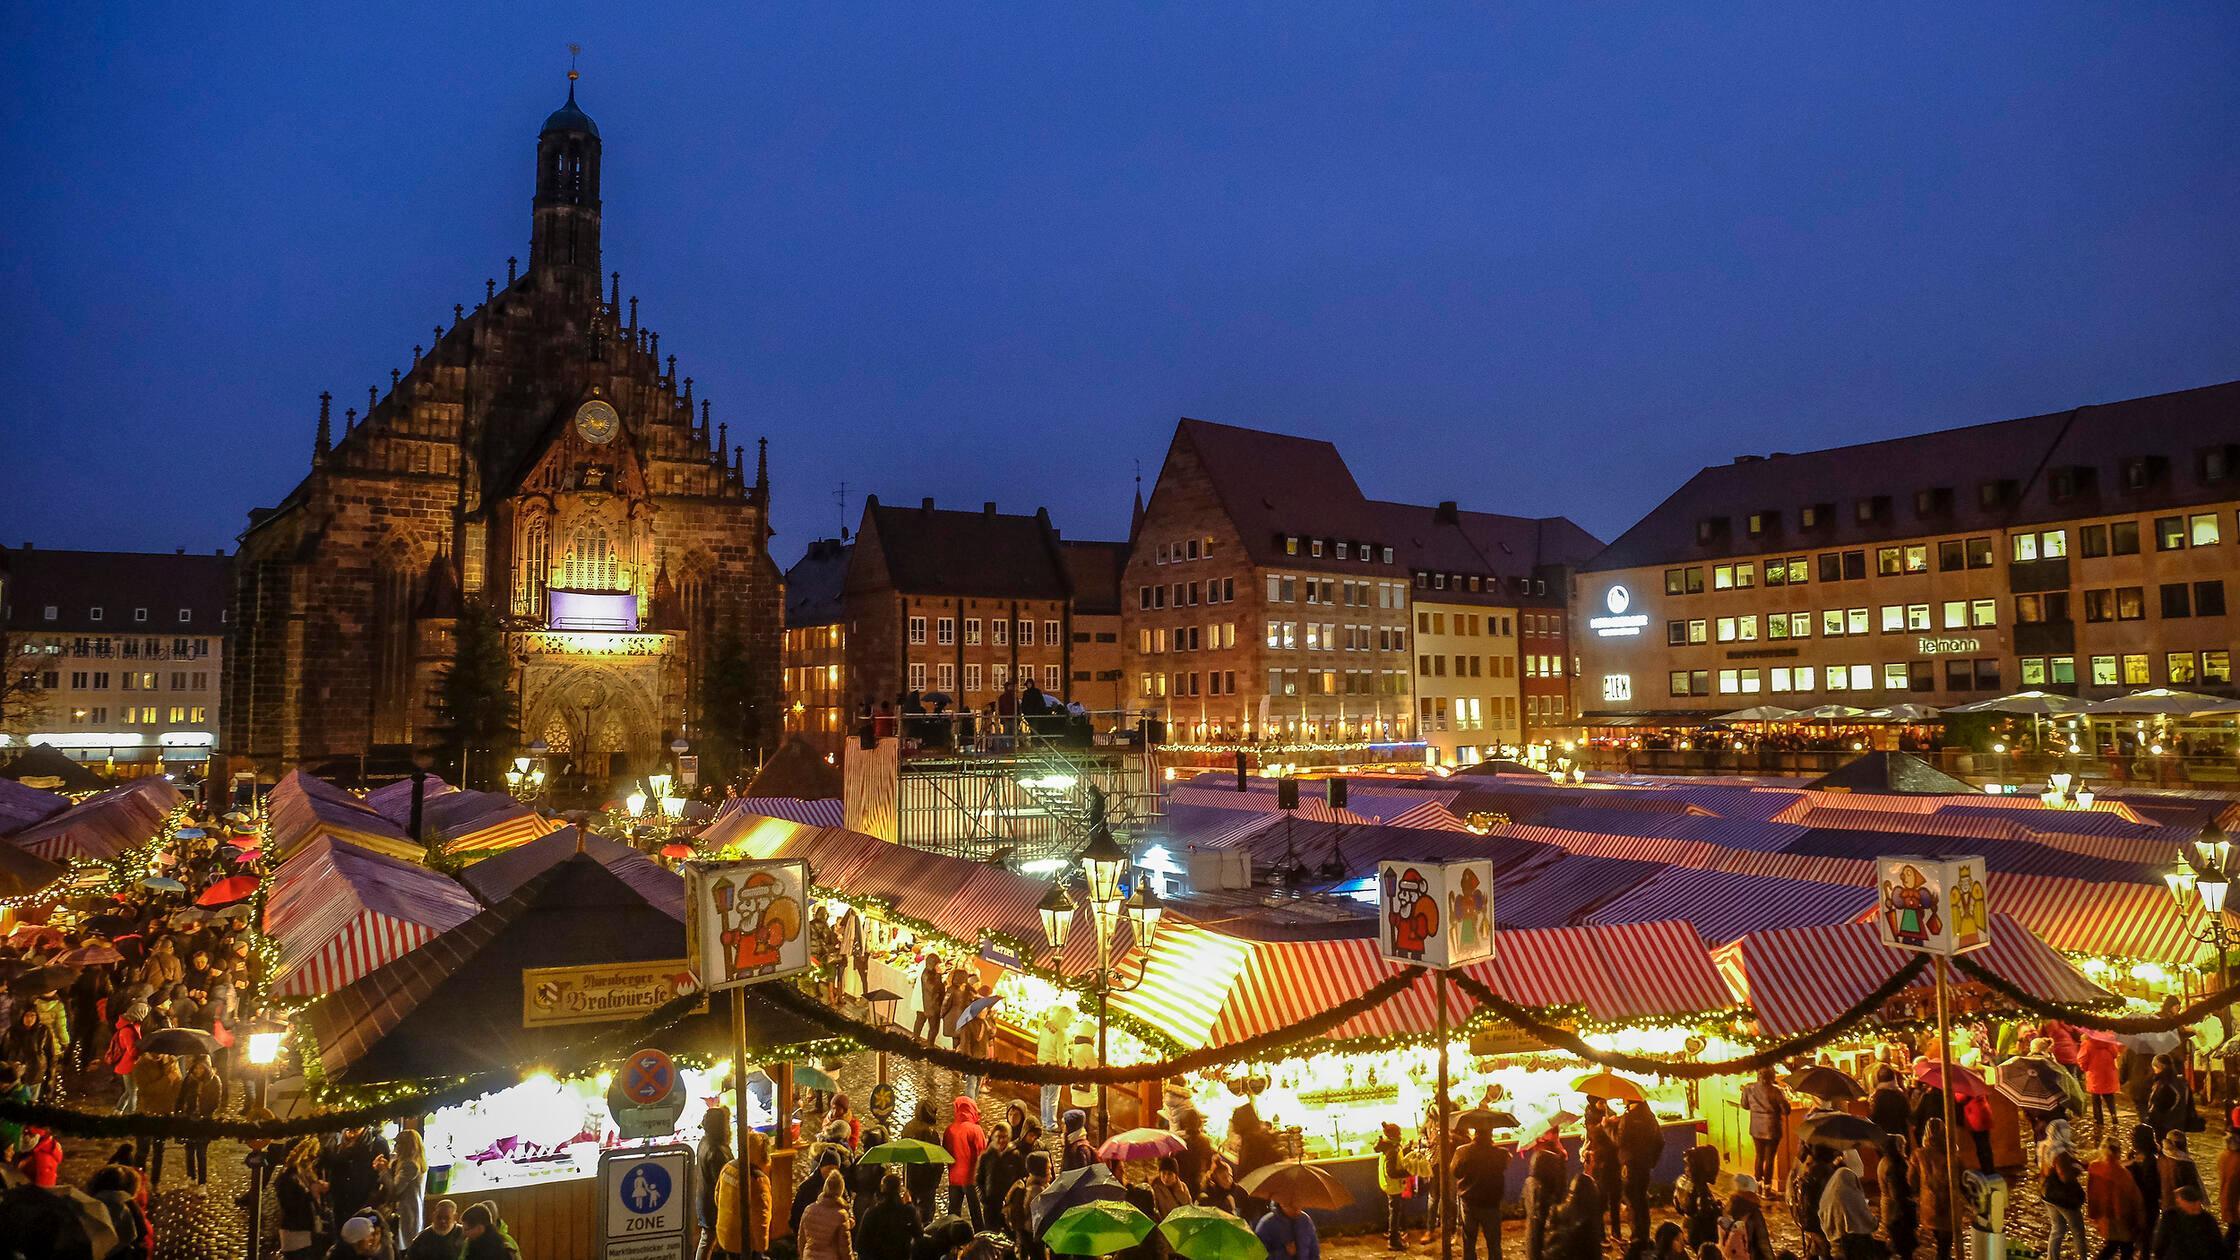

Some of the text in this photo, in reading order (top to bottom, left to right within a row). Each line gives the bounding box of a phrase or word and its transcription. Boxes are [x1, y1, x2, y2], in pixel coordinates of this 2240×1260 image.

[583, 972, 654, 989] Nürnberger
[567, 985, 668, 1011] Bratwürste
[626, 1215, 665, 1232] ZONE
